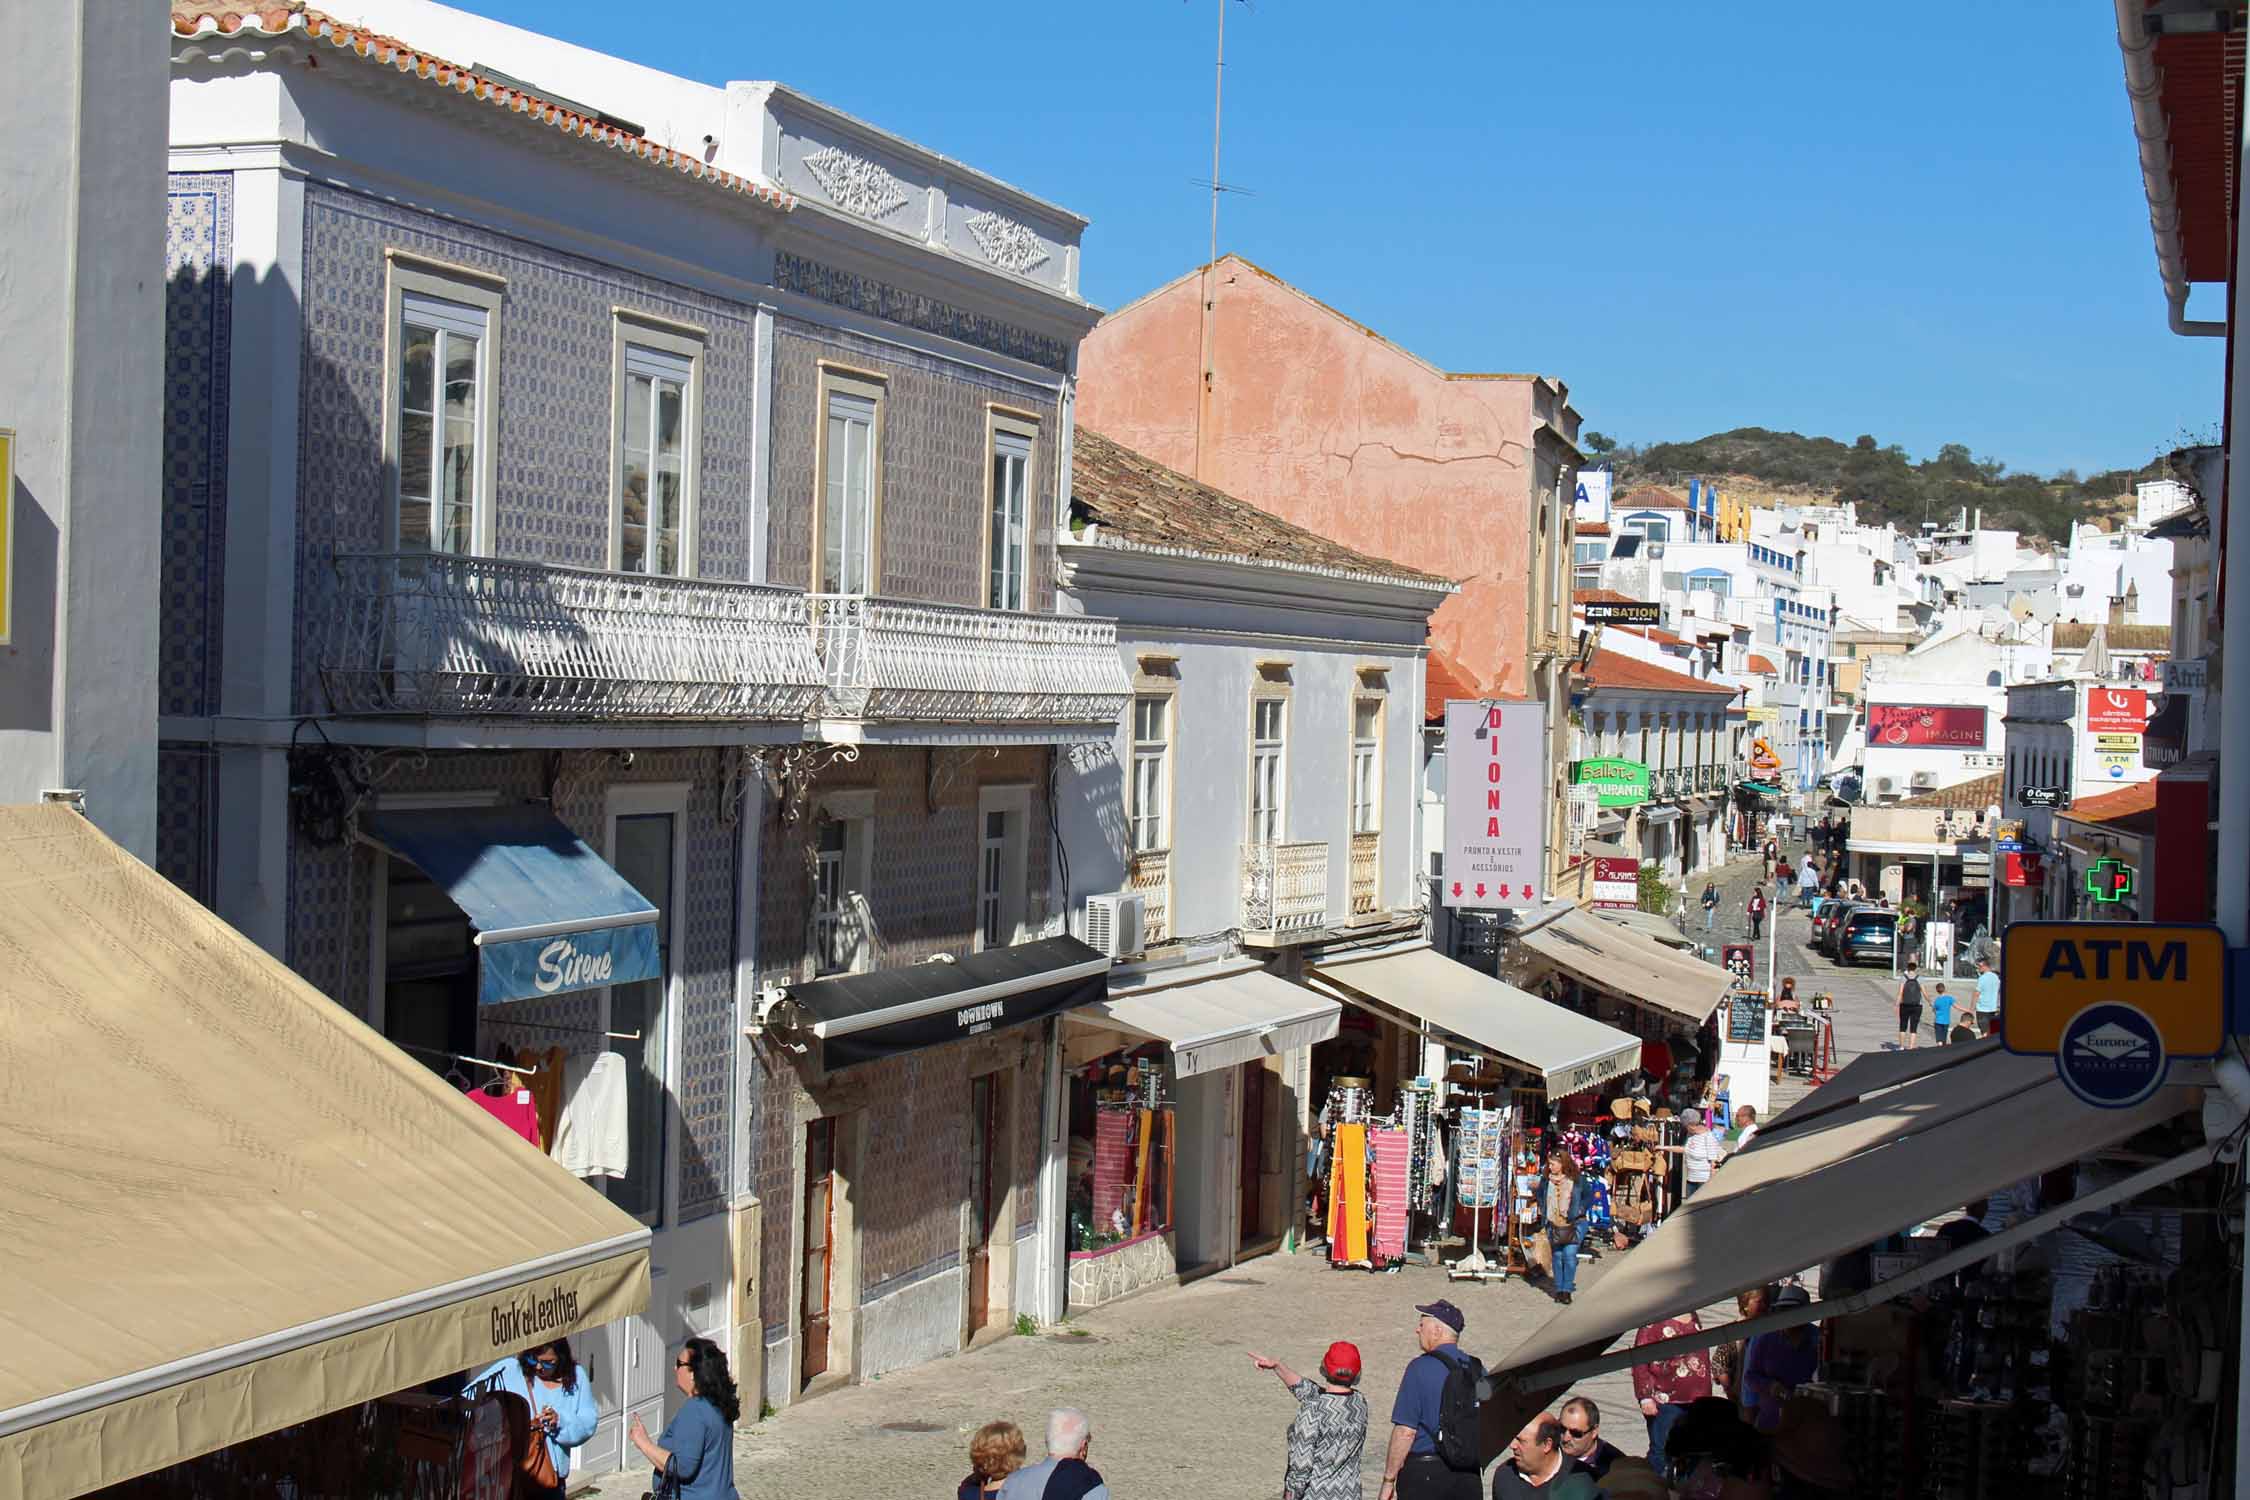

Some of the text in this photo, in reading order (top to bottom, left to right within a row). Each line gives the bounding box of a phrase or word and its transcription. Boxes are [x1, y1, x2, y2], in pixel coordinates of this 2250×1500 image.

[1587, 606, 1658, 617] ZENSATION
[1925, 729, 1984, 742] IMAGINE
[1487, 708, 1502, 837] DIONA
[1463, 846, 1490, 856] PRONTO
[1497, 848, 1522, 856] VESTIR
[2114, 874, 2127, 888] P
[535, 940, 612, 992] Sirene
[2040, 939, 2187, 981] ATM
[957, 1001, 1004, 1027] DOWNTOWN
[2087, 1034, 2137, 1048] Euronet
[1574, 1056, 1617, 1087] DIONA DIONA
